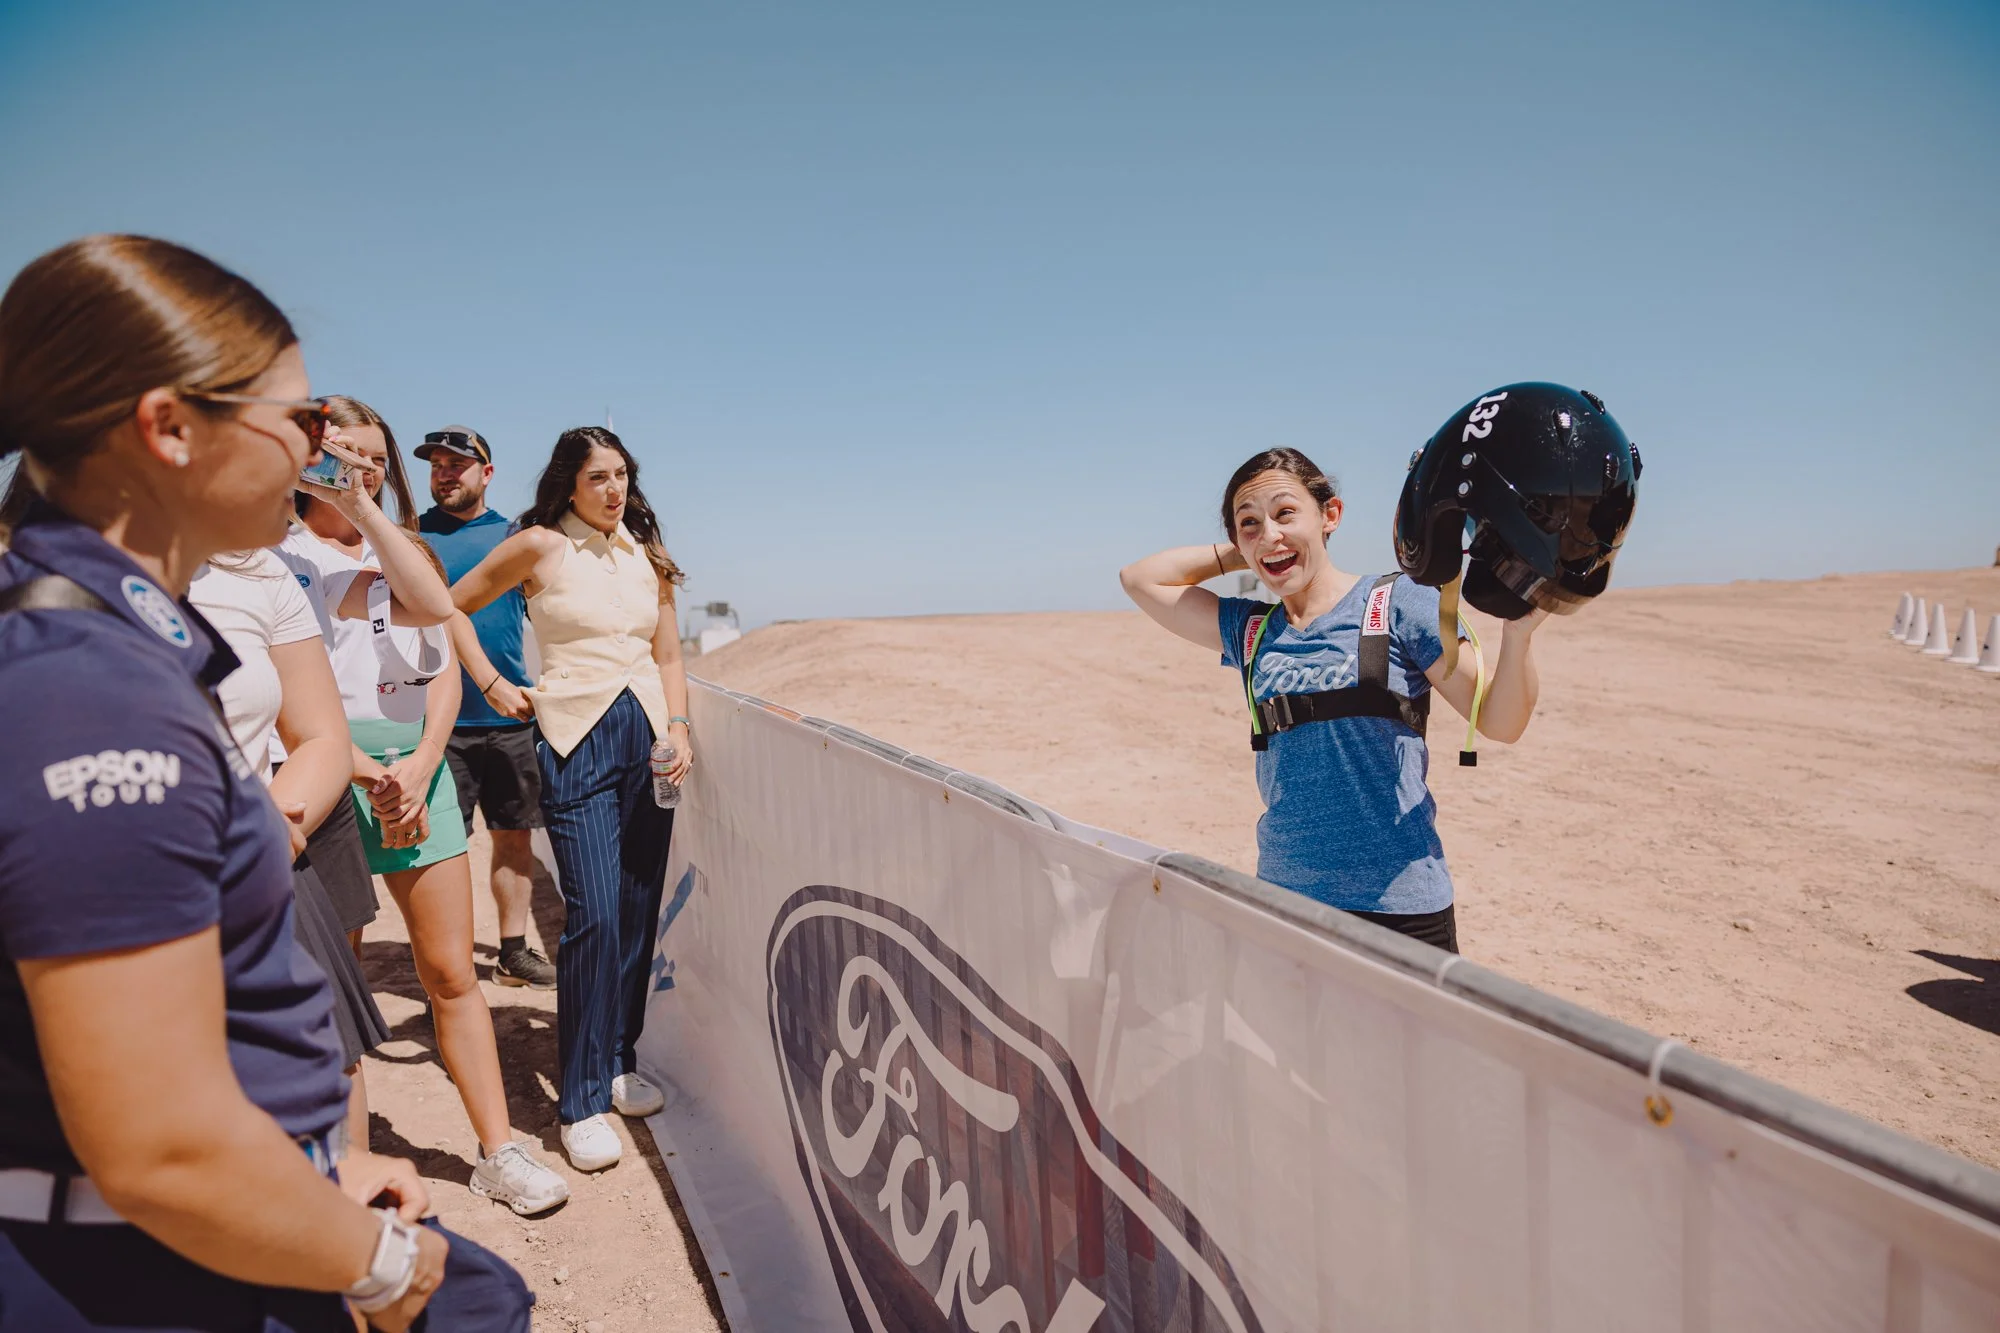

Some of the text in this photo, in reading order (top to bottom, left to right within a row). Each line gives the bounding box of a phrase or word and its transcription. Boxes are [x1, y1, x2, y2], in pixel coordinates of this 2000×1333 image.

[1462, 392, 1508, 443] 132
[1369, 591, 1385, 628] SIMPSON
[1251, 649, 1357, 698] Ford
[43, 749, 181, 801] EPSON
[68, 781, 166, 813] TOUR
